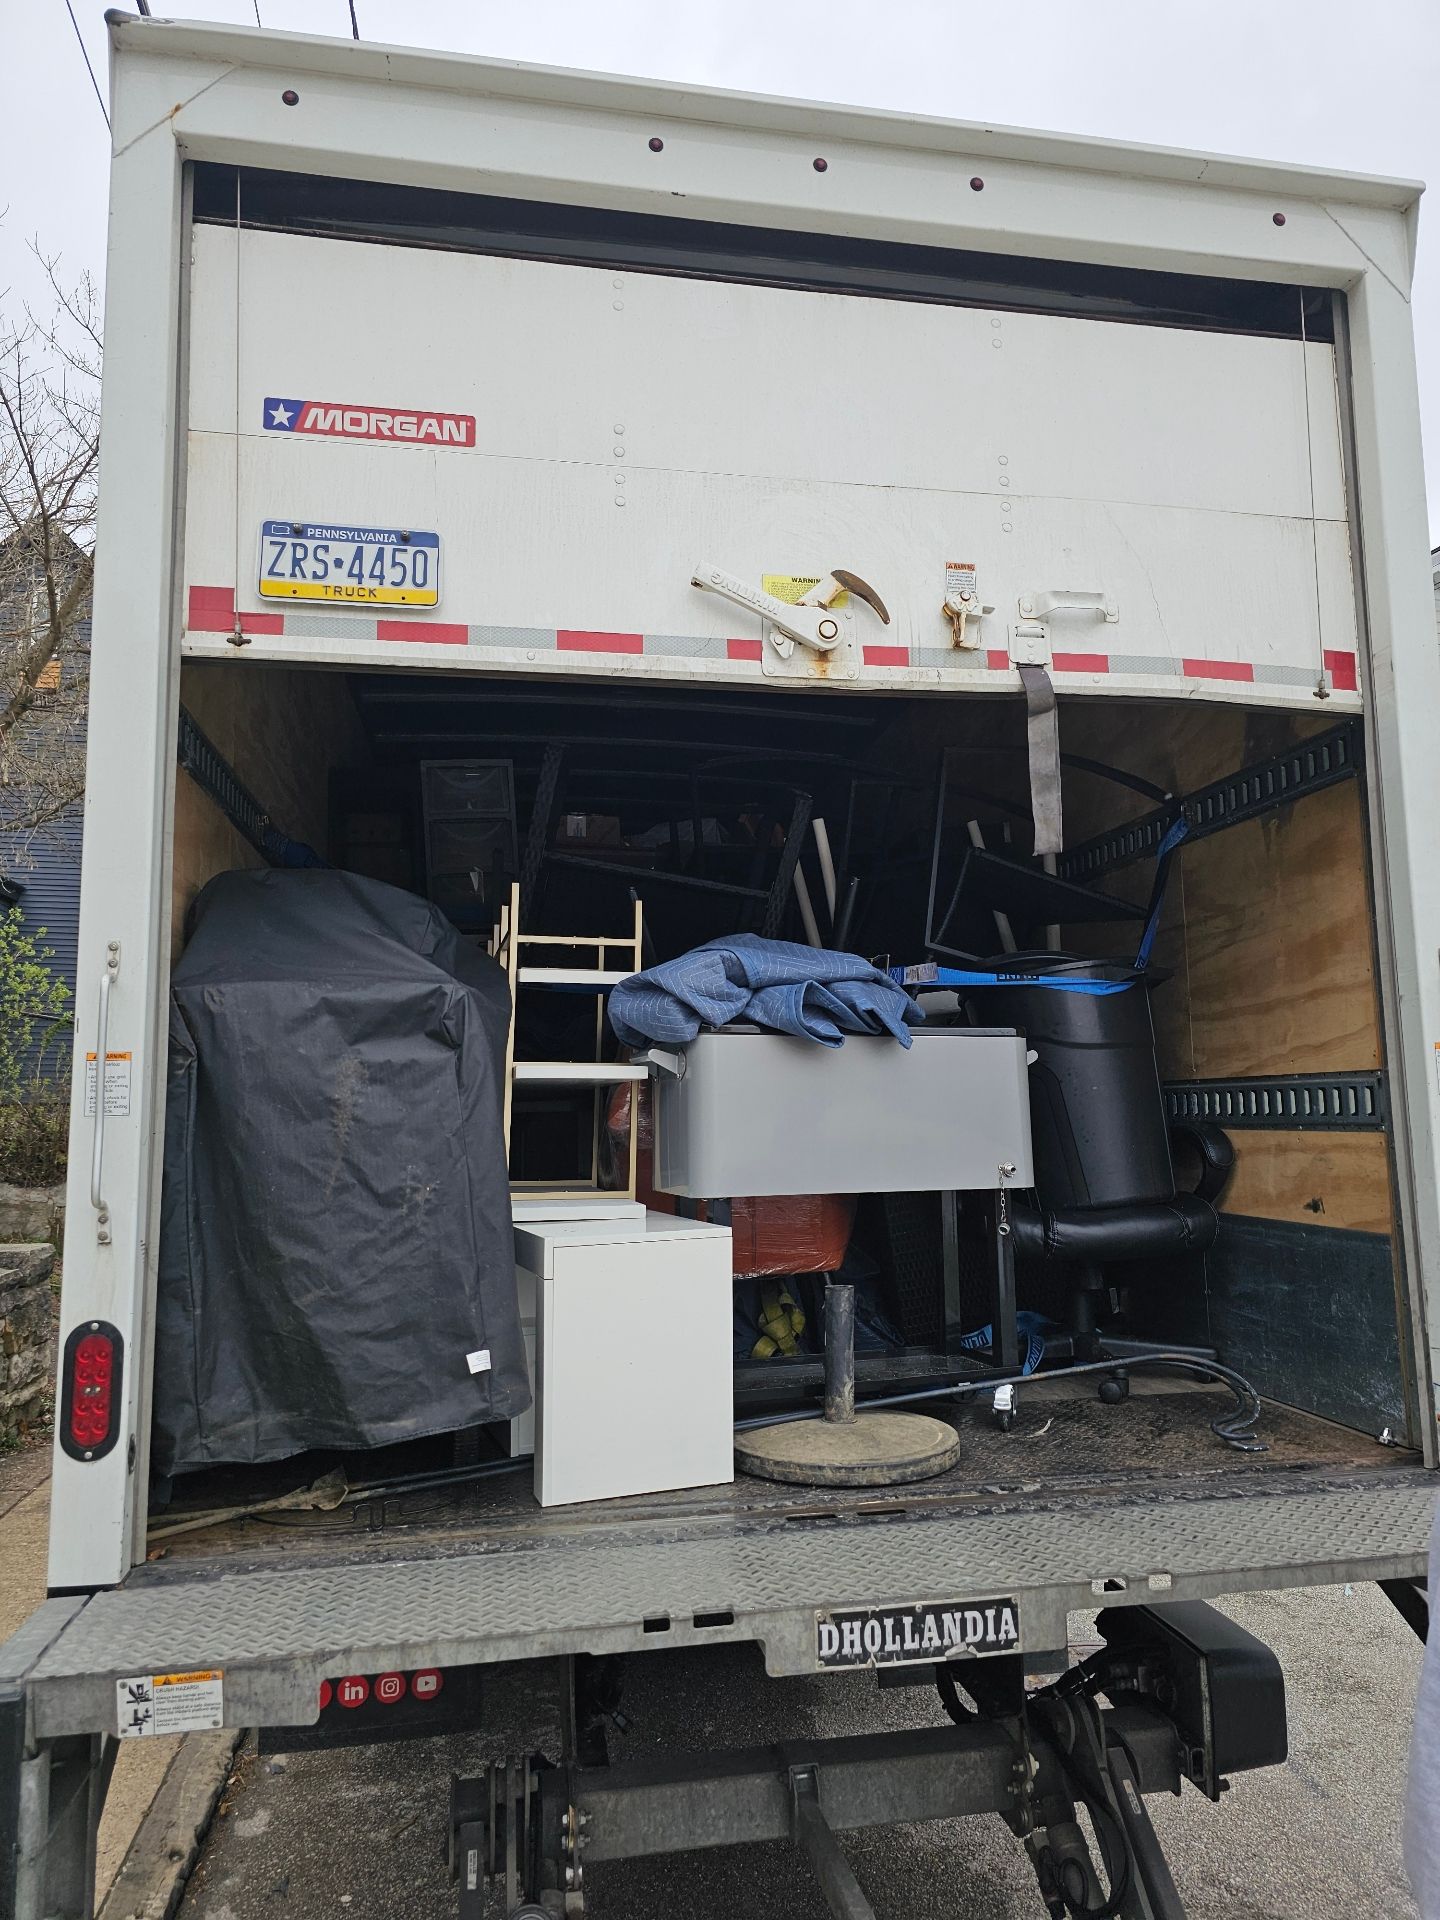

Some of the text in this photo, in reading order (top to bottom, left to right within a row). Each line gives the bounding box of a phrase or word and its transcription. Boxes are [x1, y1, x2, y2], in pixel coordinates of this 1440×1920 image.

[304, 408, 467, 442] MORGAN
[307, 528, 397, 543] PENNSYLVANIA
[323, 585, 377, 598] TRUCK
[960, 1334, 986, 1349] ULIN
[819, 1607, 1018, 1657] DHOLLANDIA
[176, 1673, 211, 1683] WARNING
